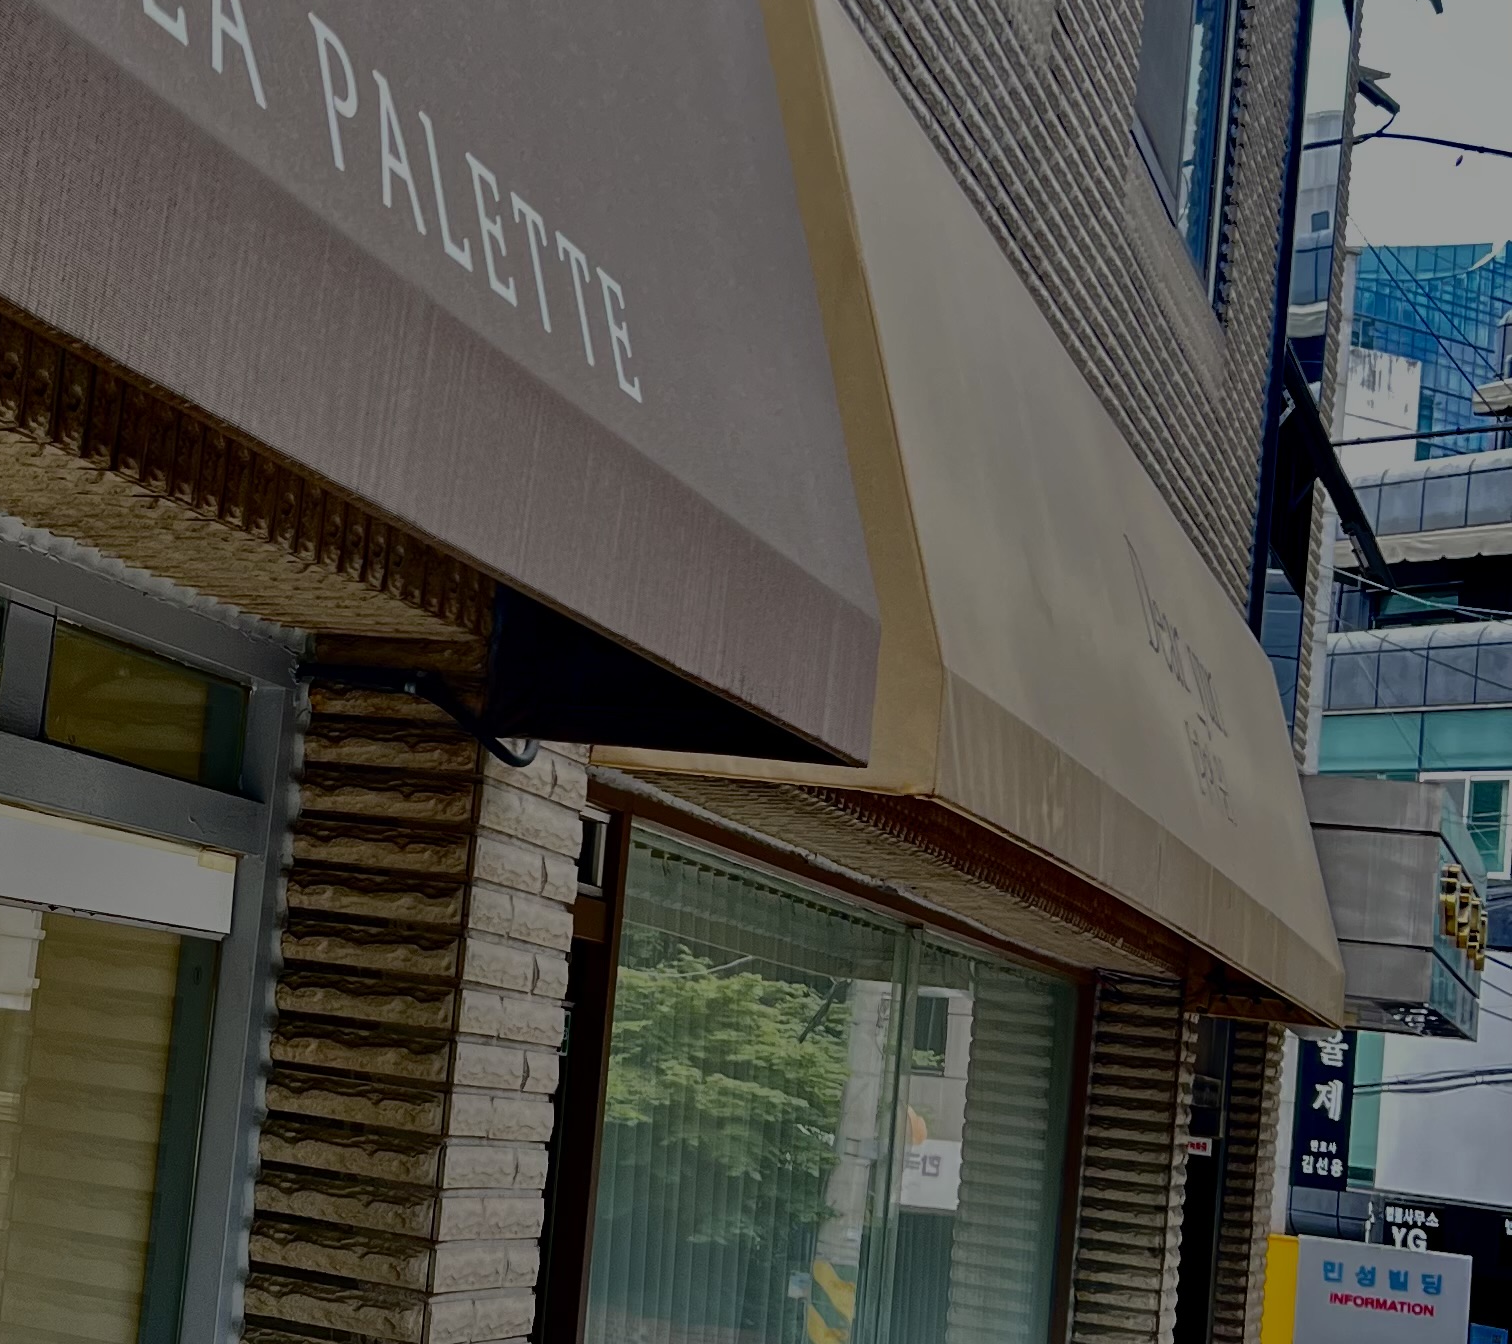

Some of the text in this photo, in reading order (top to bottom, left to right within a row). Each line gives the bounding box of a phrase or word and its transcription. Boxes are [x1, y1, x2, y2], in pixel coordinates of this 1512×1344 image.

[308, 12, 642, 404] PALETTE
[1391, 1225, 1428, 1253] YG
[1329, 1292, 1435, 1317] INFORMATION
